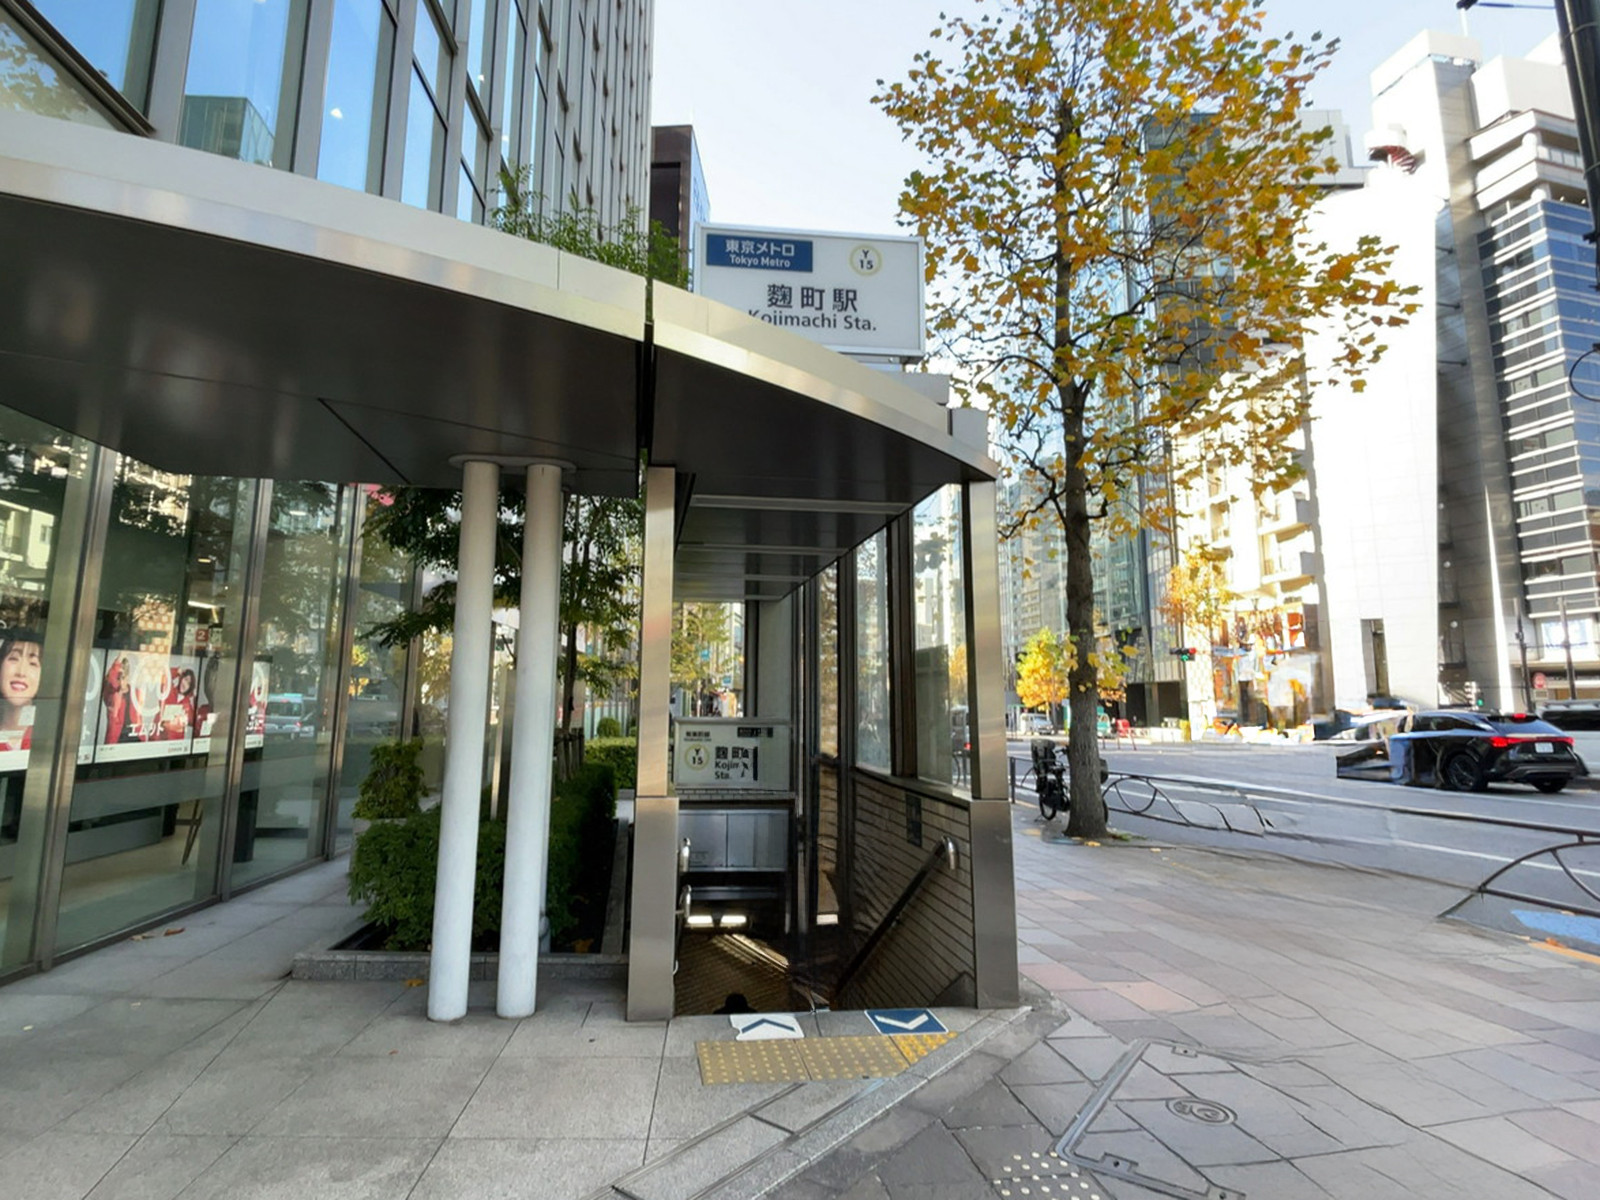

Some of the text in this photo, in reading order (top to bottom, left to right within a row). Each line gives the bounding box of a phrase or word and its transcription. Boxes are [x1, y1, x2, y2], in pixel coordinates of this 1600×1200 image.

[725, 240, 795, 256] 東京メトロ
[862, 249, 870, 259] Y
[729, 254, 791, 268] Tokyo Metro
[859, 259, 873, 270] 15
[843, 314, 877, 331] Sta.
[197, 630, 206, 640] 2
[694, 748, 701, 756] Y
[692, 756, 704, 765] 15
